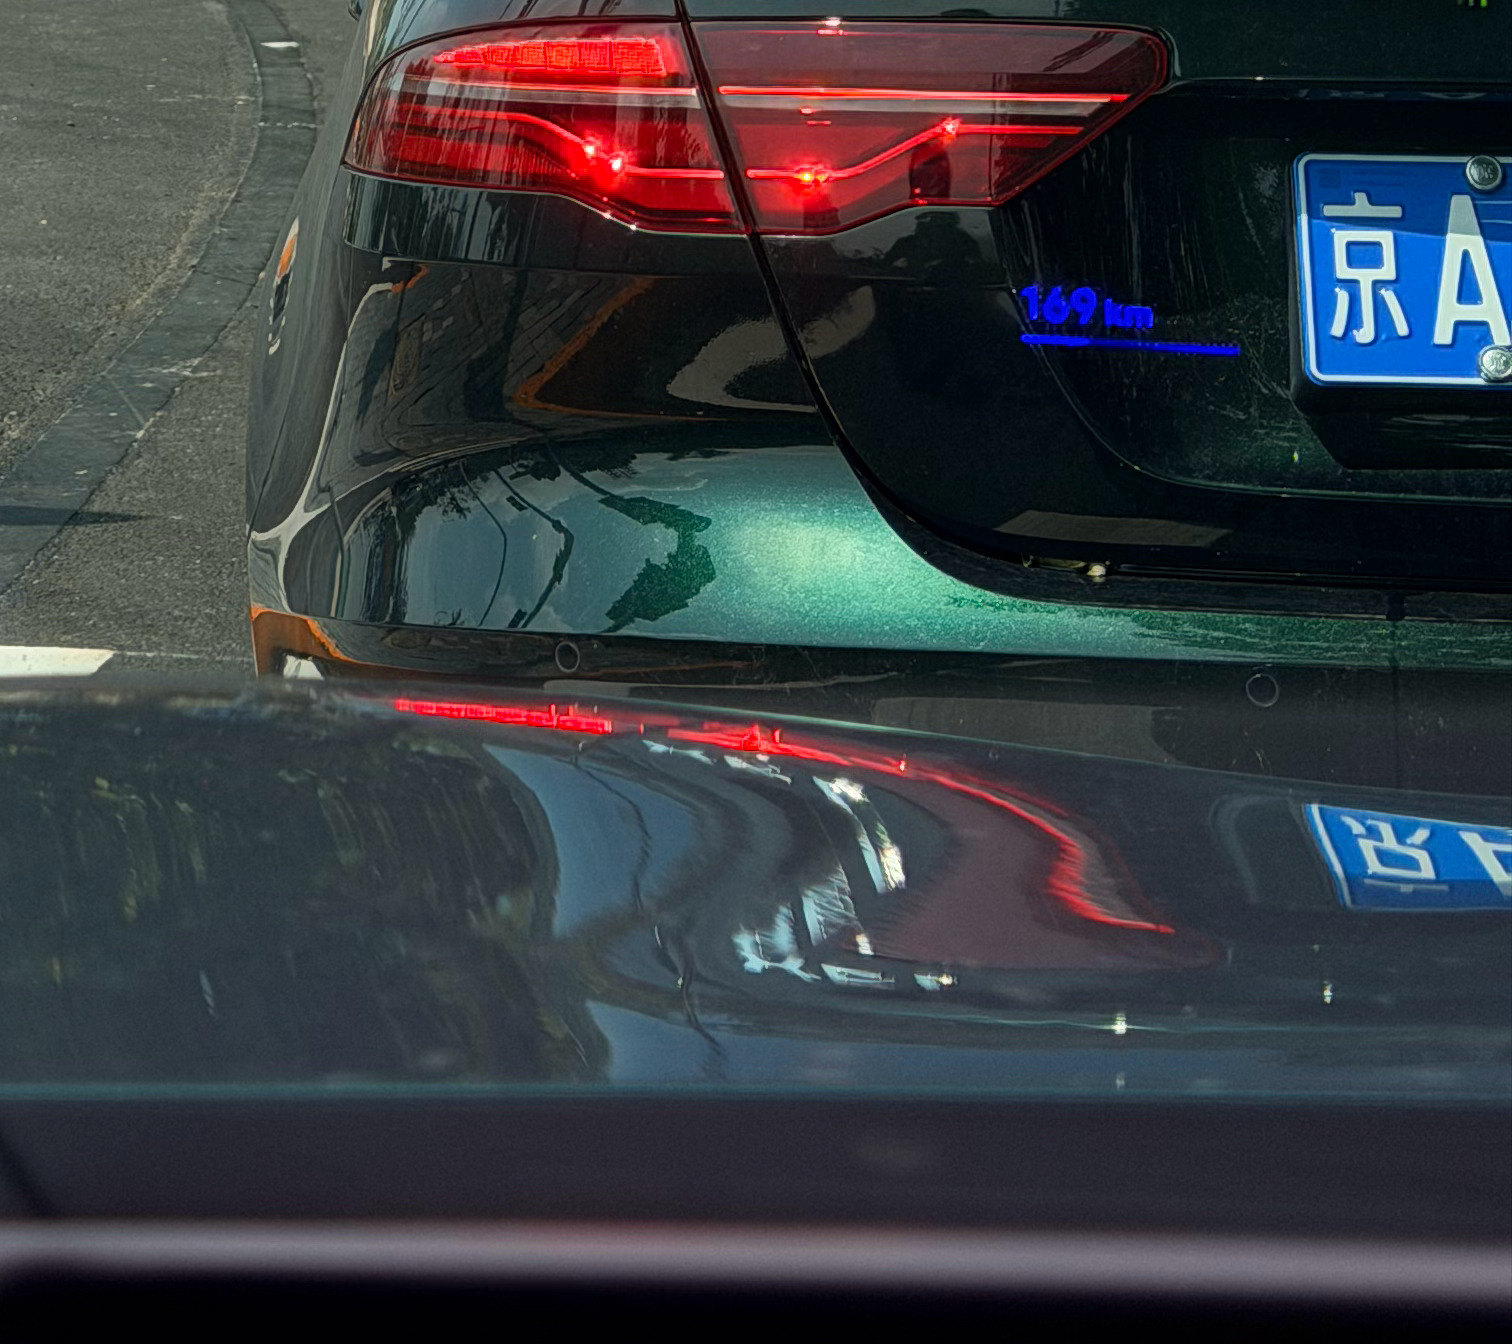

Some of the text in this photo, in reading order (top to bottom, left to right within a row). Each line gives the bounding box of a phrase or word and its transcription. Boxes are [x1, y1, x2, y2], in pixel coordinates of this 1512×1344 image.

[1020, 286, 1155, 329] 169 km
[1323, 191, 1512, 346] 京A
